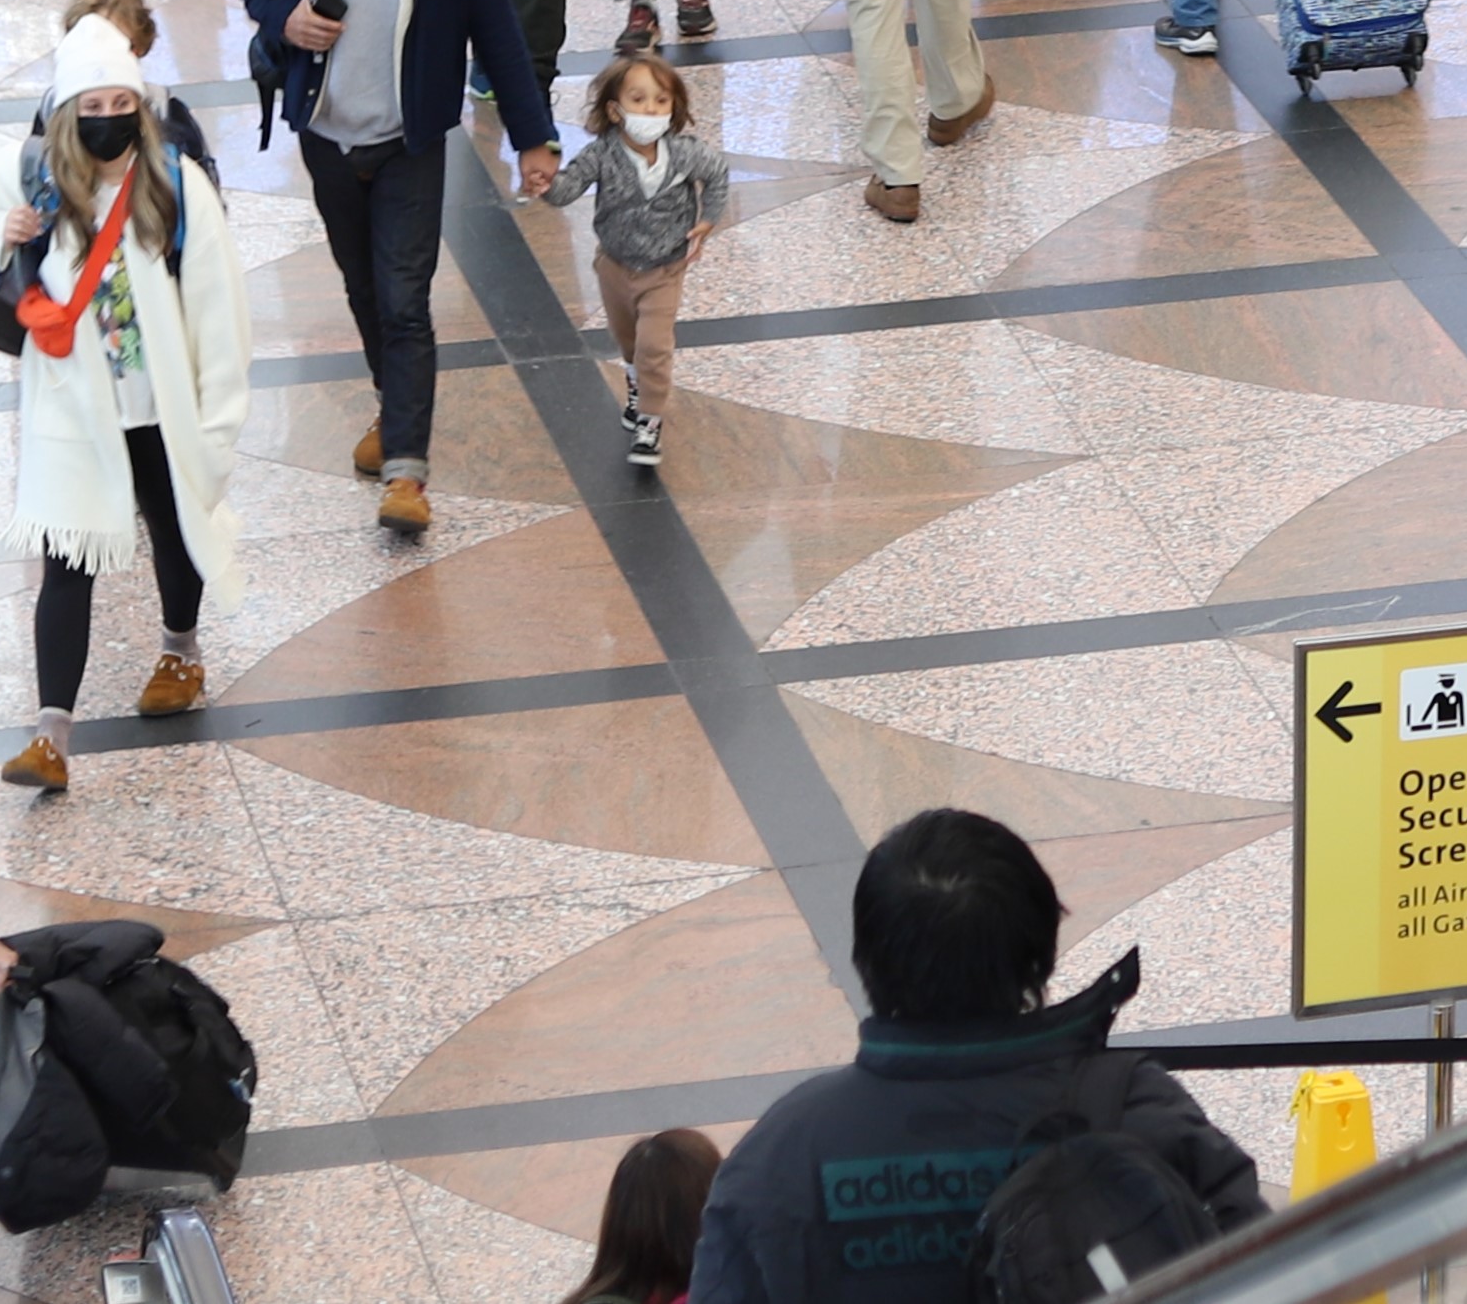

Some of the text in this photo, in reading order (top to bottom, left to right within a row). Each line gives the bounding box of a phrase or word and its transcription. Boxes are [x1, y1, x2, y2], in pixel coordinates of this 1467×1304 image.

[1398, 886, 1426, 909] all
[1398, 916, 1426, 939] all
[835, 1161, 996, 1209] adidas
